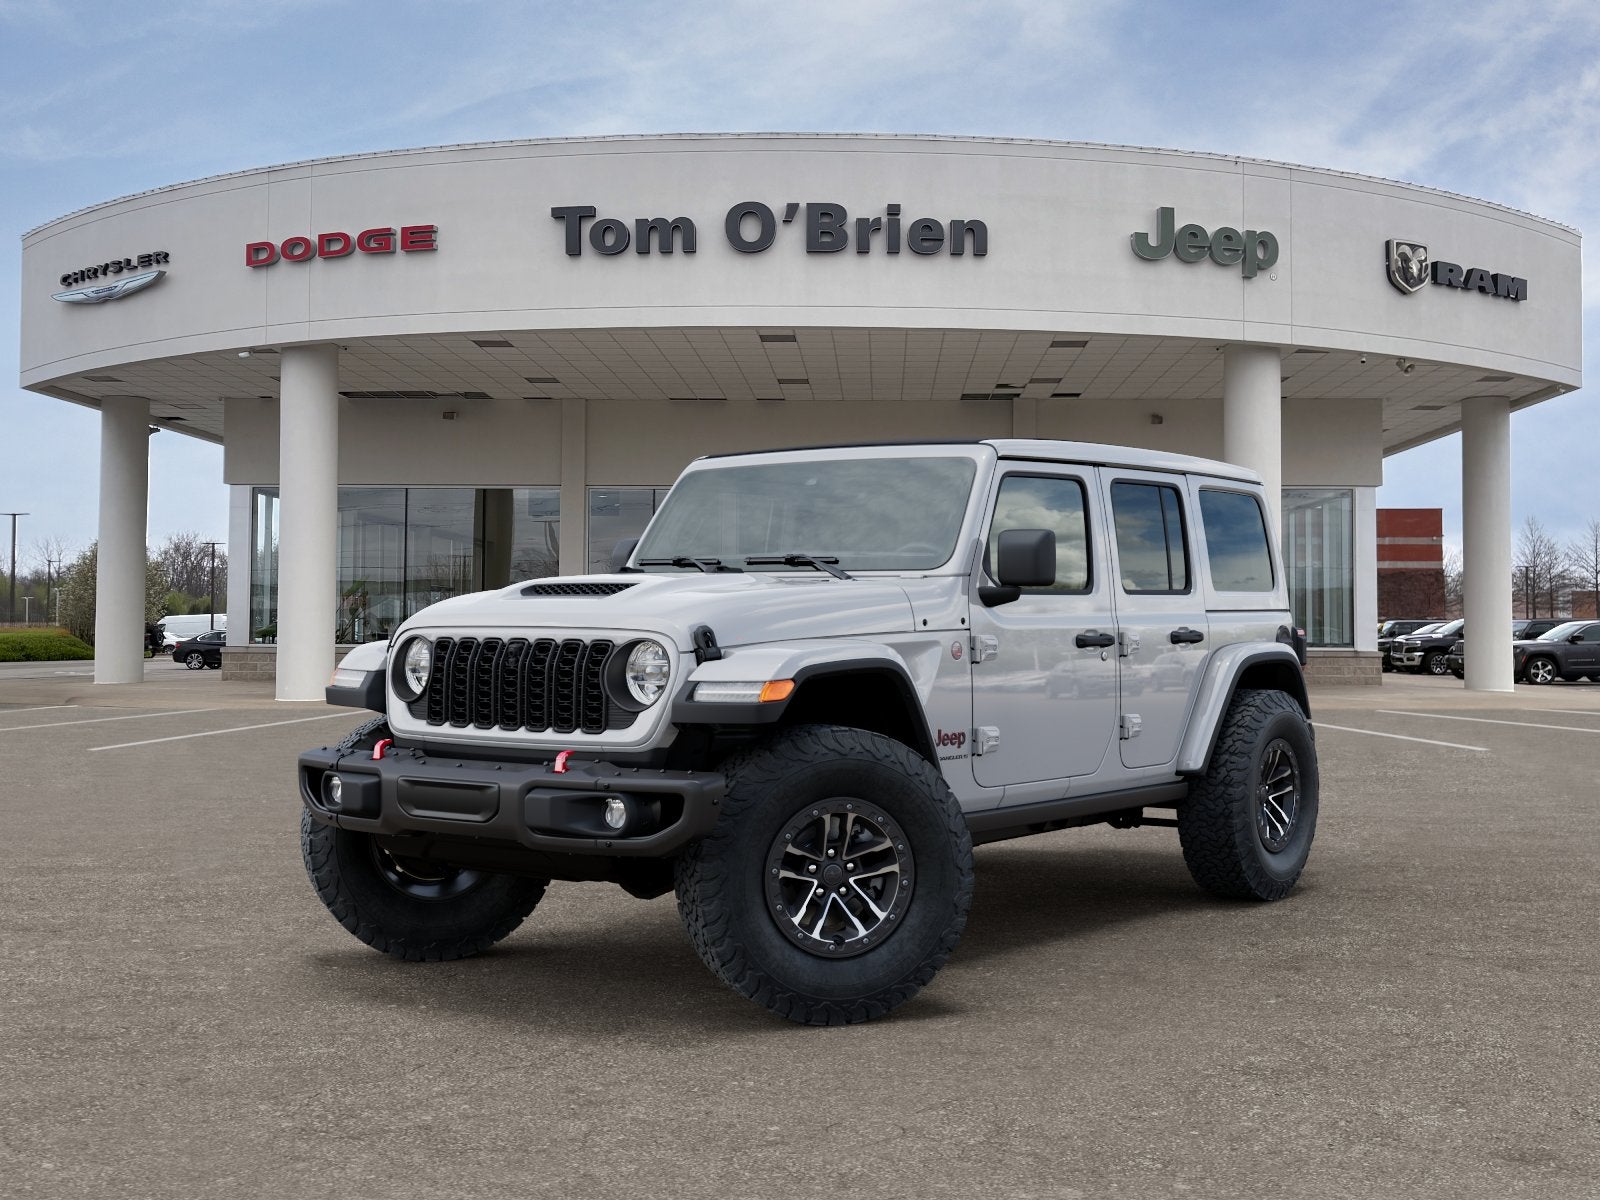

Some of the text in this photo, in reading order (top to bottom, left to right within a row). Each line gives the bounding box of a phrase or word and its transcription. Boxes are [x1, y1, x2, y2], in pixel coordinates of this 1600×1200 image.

[245, 224, 438, 269] DODGE
[551, 201, 989, 257] Tom O'Brien
[1130, 206, 1280, 279] Jeep
[59, 250, 170, 287] CHRYSLER
[1430, 260, 1528, 301] RAM
[935, 728, 966, 749] Jeep
